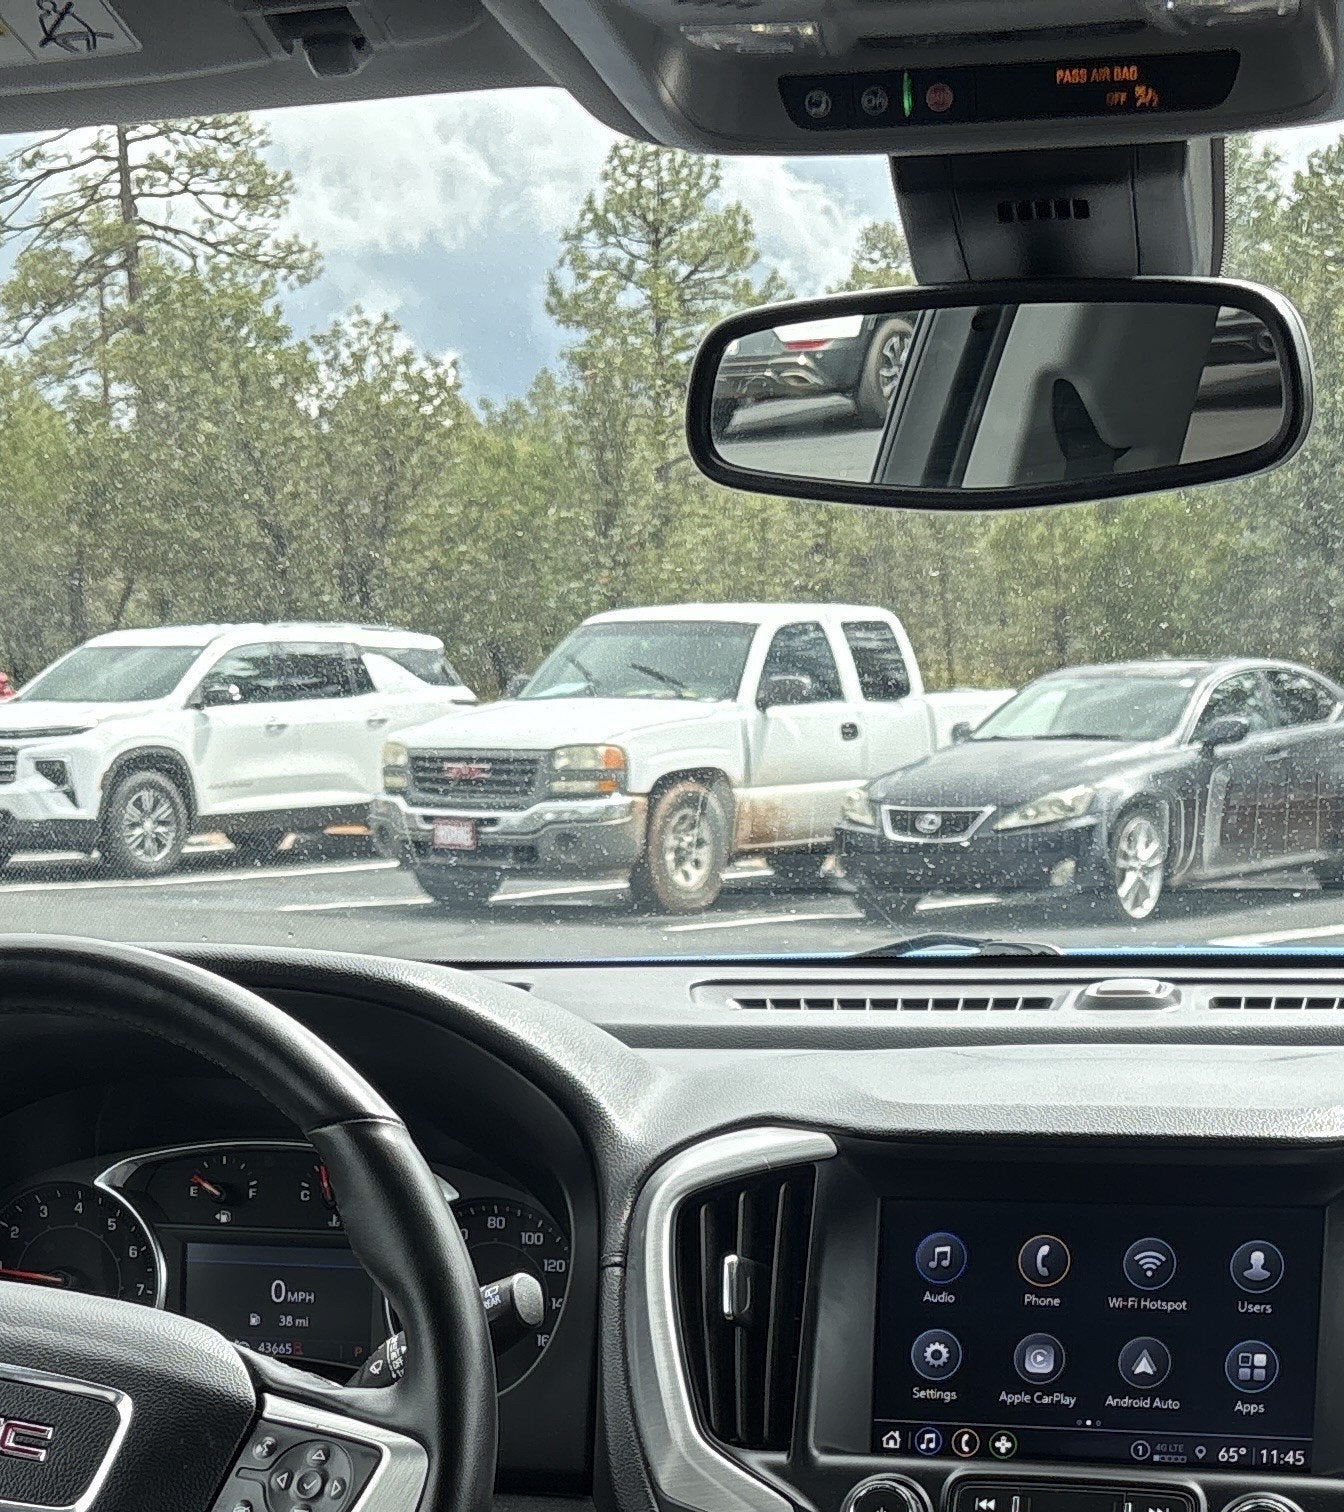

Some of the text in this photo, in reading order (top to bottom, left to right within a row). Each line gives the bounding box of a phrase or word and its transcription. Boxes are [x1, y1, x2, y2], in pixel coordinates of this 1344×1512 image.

[1056, 68, 1087, 85] PASS
[189, 1187, 199, 1197] E
[248, 1188, 256, 1199] F
[300, 1190, 310, 1201] C
[39, 1205, 48, 1218] 3
[74, 1202, 83, 1214] 4
[107, 1218, 116, 1231] 5
[487, 1216, 506, 1229] 80
[10, 1226, 20, 1239] 2
[520, 1232, 544, 1245] 100
[128, 1245, 138, 1258] 6
[543, 1259, 566, 1273] 120
[136, 1283, 145, 1296] 7
[271, 1280, 315, 1304] 0 MPH
[922, 1290, 955, 1304] Audio
[1024, 1294, 1061, 1307] Phone
[1108, 1297, 1187, 1313] Wi-Fi Hotspot
[1237, 1301, 1273, 1314] Users
[278, 1315, 309, 1328] 38 mi
[912, 1387, 957, 1404] Settings
[999, 1391, 1077, 1408] Apple CarPlay
[1105, 1395, 1180, 1410] Android Auto
[1234, 1400, 1265, 1416] Apps
[1169, 1443, 1184, 1453] LTE
[1218, 1446, 1247, 1462] 65°
[1260, 1448, 1305, 1466] 11:45
